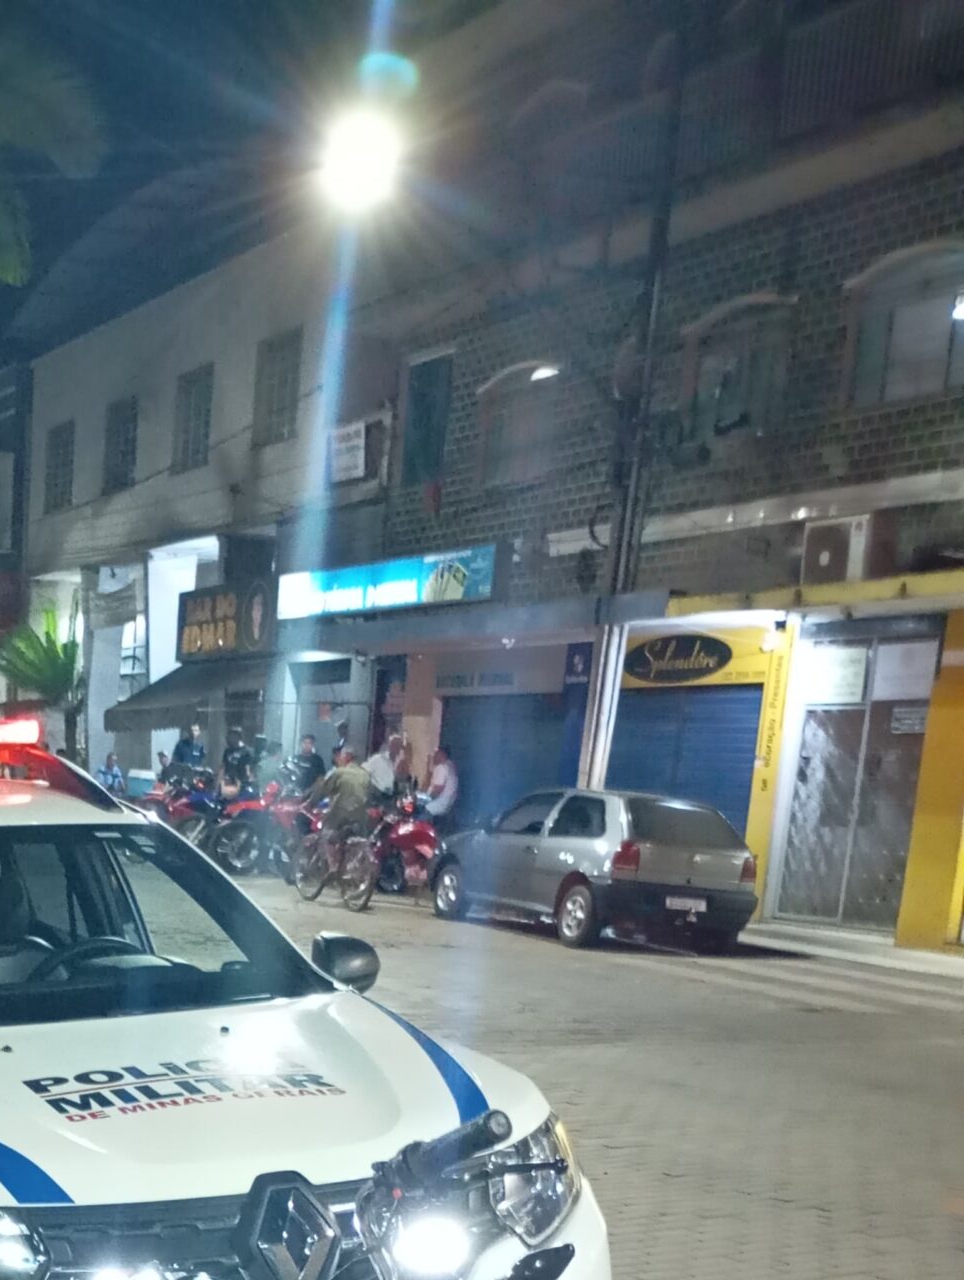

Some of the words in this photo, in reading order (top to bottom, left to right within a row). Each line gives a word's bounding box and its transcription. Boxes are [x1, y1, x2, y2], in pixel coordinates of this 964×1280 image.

[44, 1073, 335, 1115] MILITAR
[65, 1110, 110, 1123] DE
[118, 1093, 224, 1116] MINAS
